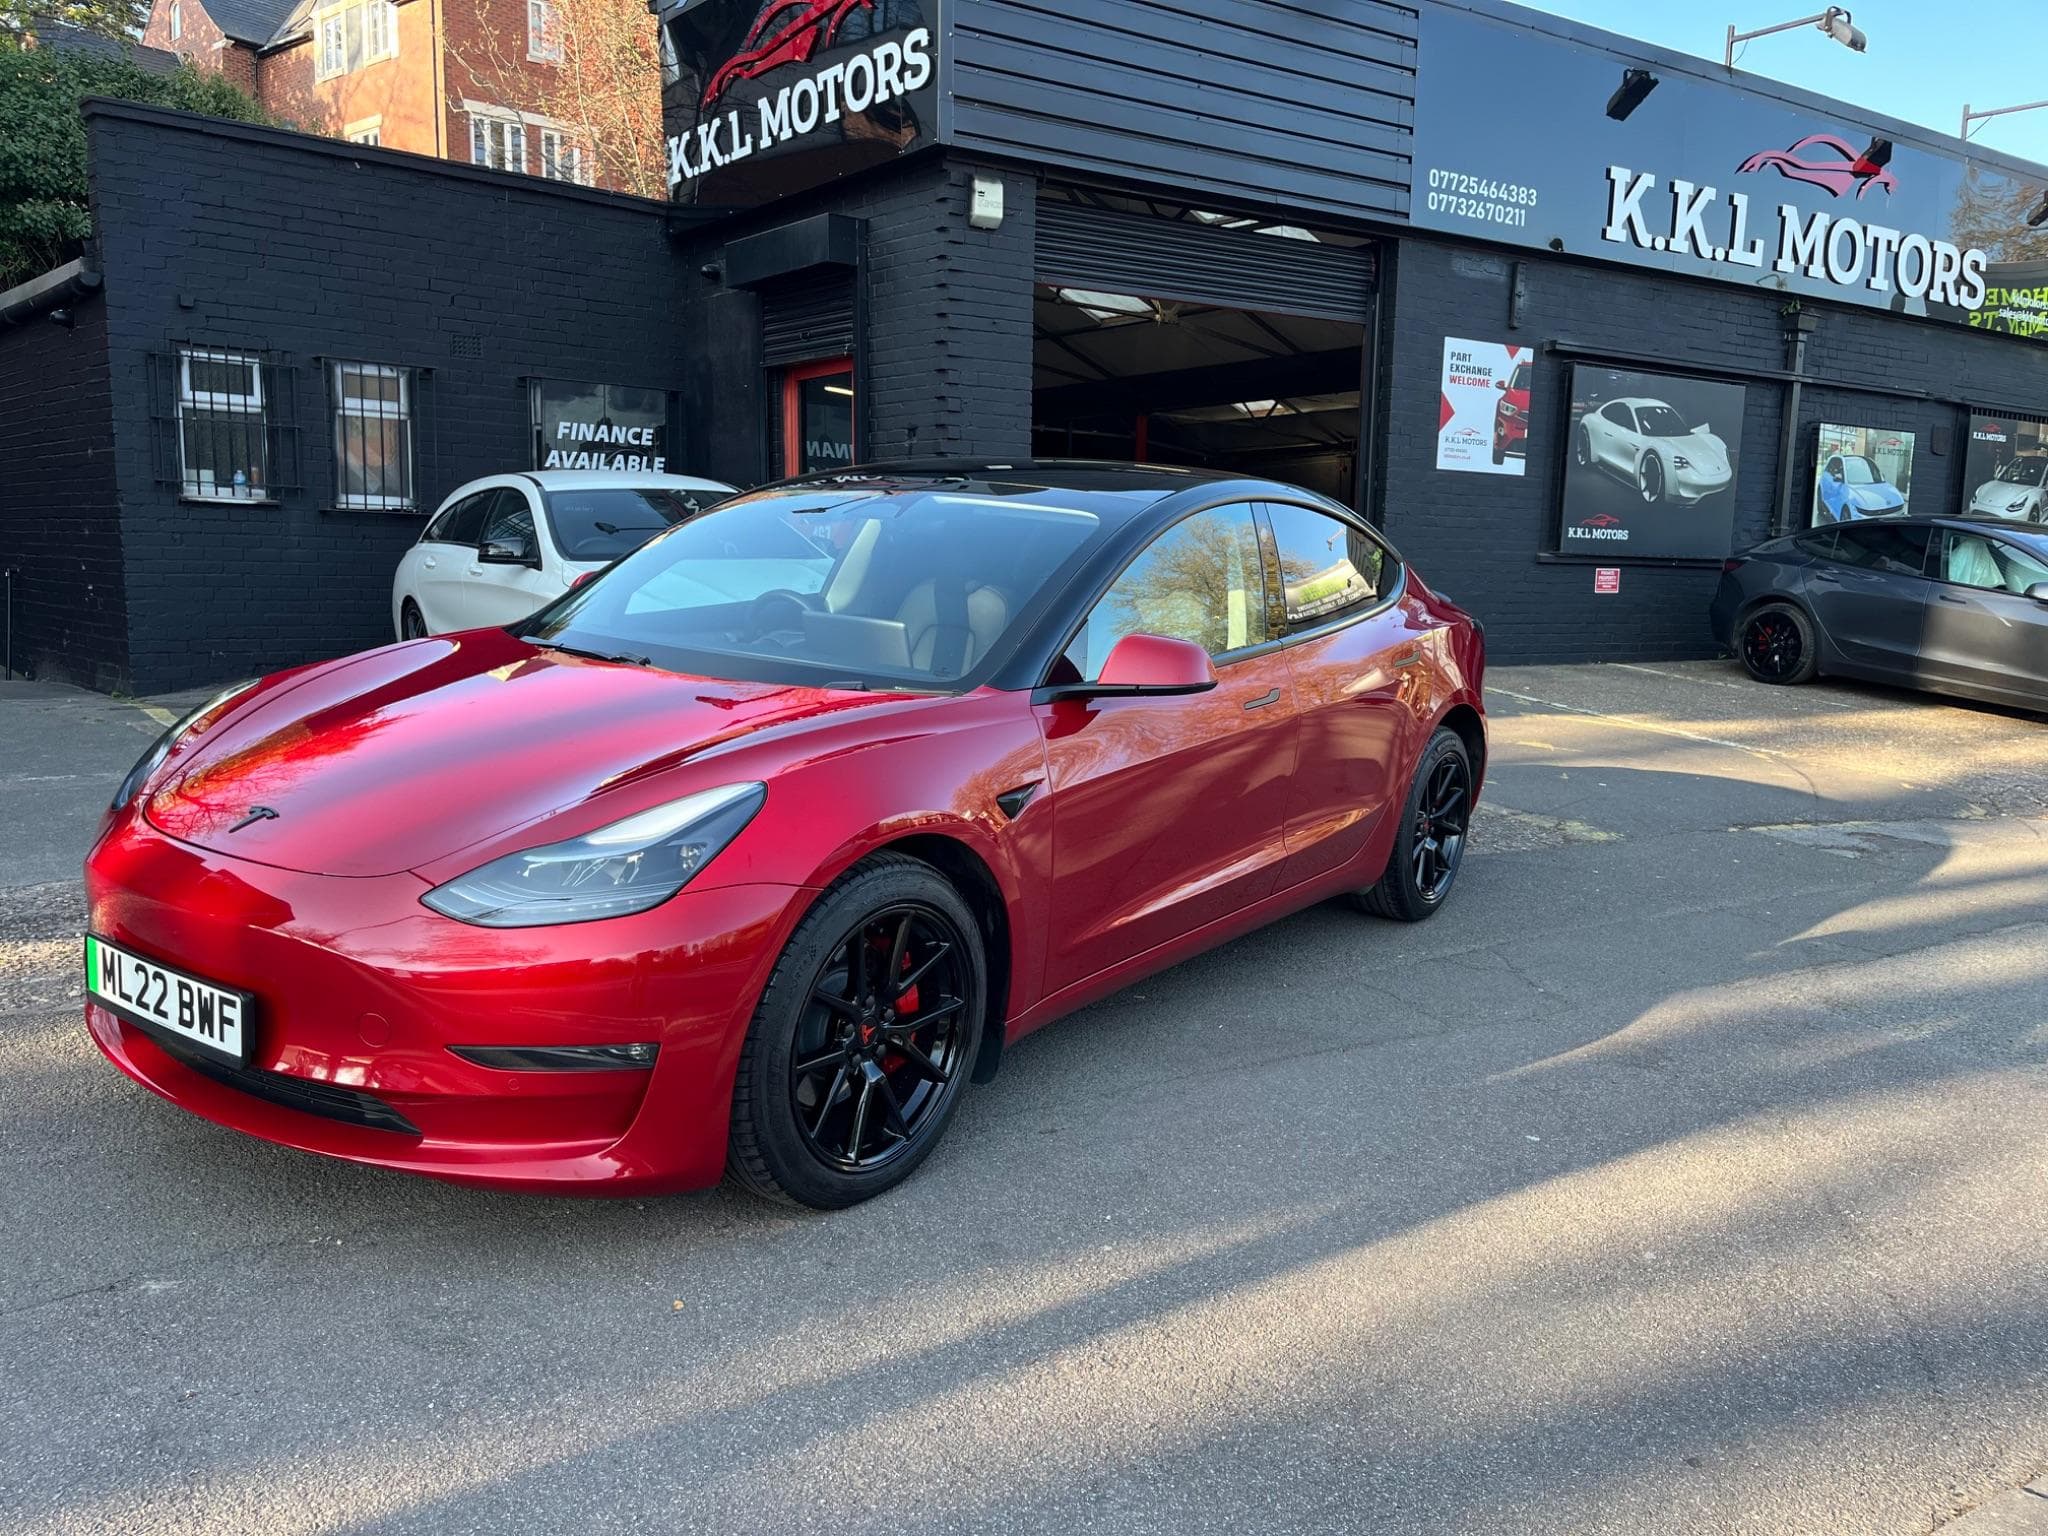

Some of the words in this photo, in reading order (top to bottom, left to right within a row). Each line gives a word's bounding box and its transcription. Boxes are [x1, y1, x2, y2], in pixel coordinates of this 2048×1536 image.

[668, 110, 753, 186] K.K.L
[757, 27, 932, 151] MOTORS
[1429, 168, 1538, 206] 07725464383
[1427, 192, 1526, 227] 07732670211
[1604, 166, 1765, 267] K.K.L
[1776, 204, 1988, 311] MOTORS
[1450, 351, 1472, 363] PART
[1448, 375, 1491, 388] WELCOME
[1449, 363, 1493, 377] EXCHANGE
[556, 421, 654, 446] FINANCE
[1462, 438, 1488, 446] MOTORS
[544, 449, 666, 473] AVAILABLE
[1592, 528, 1630, 541] MOTORS
[101, 947, 169, 1020] ML22
[177, 979, 237, 1043] BWF
